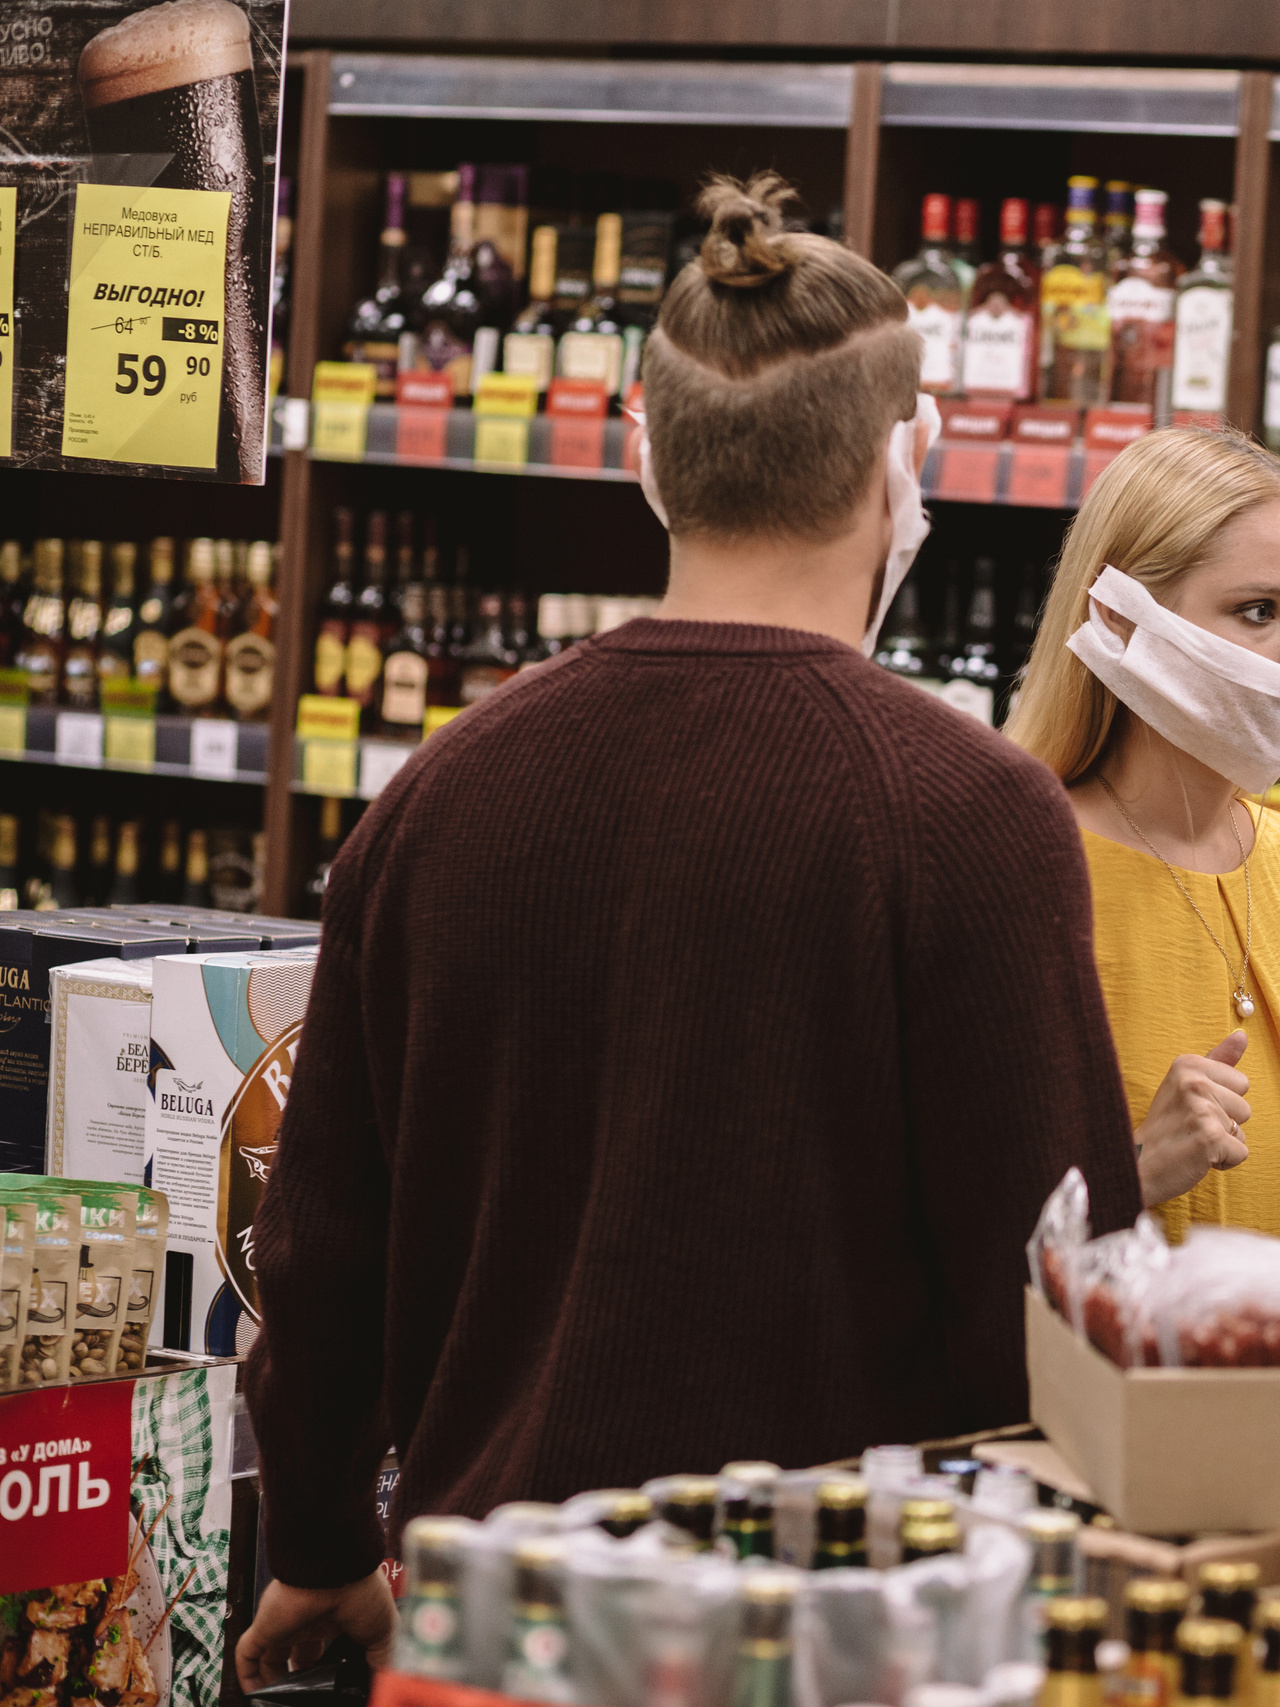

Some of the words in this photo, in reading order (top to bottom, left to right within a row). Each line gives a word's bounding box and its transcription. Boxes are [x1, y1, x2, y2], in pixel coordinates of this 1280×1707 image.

[121, 207, 178, 224] Медовуха
[83, 223, 185, 241] НЕПРАВИЛЬНЫЙ
[187, 230, 214, 246] МЕД
[132, 244, 163, 258] СТ/Б.
[93, 283, 205, 308] ВЫГОДНО!
[115, 316, 134, 335] 64
[115, 352, 167, 397] 59
[186, 356, 211, 377] 90
[180, 391, 197, 404] руб
[161, 1093, 214, 1117] BELUGA
[32, 1437, 92, 1463] ДОМА»
[0, 1461, 111, 1522] ОЛЬ
